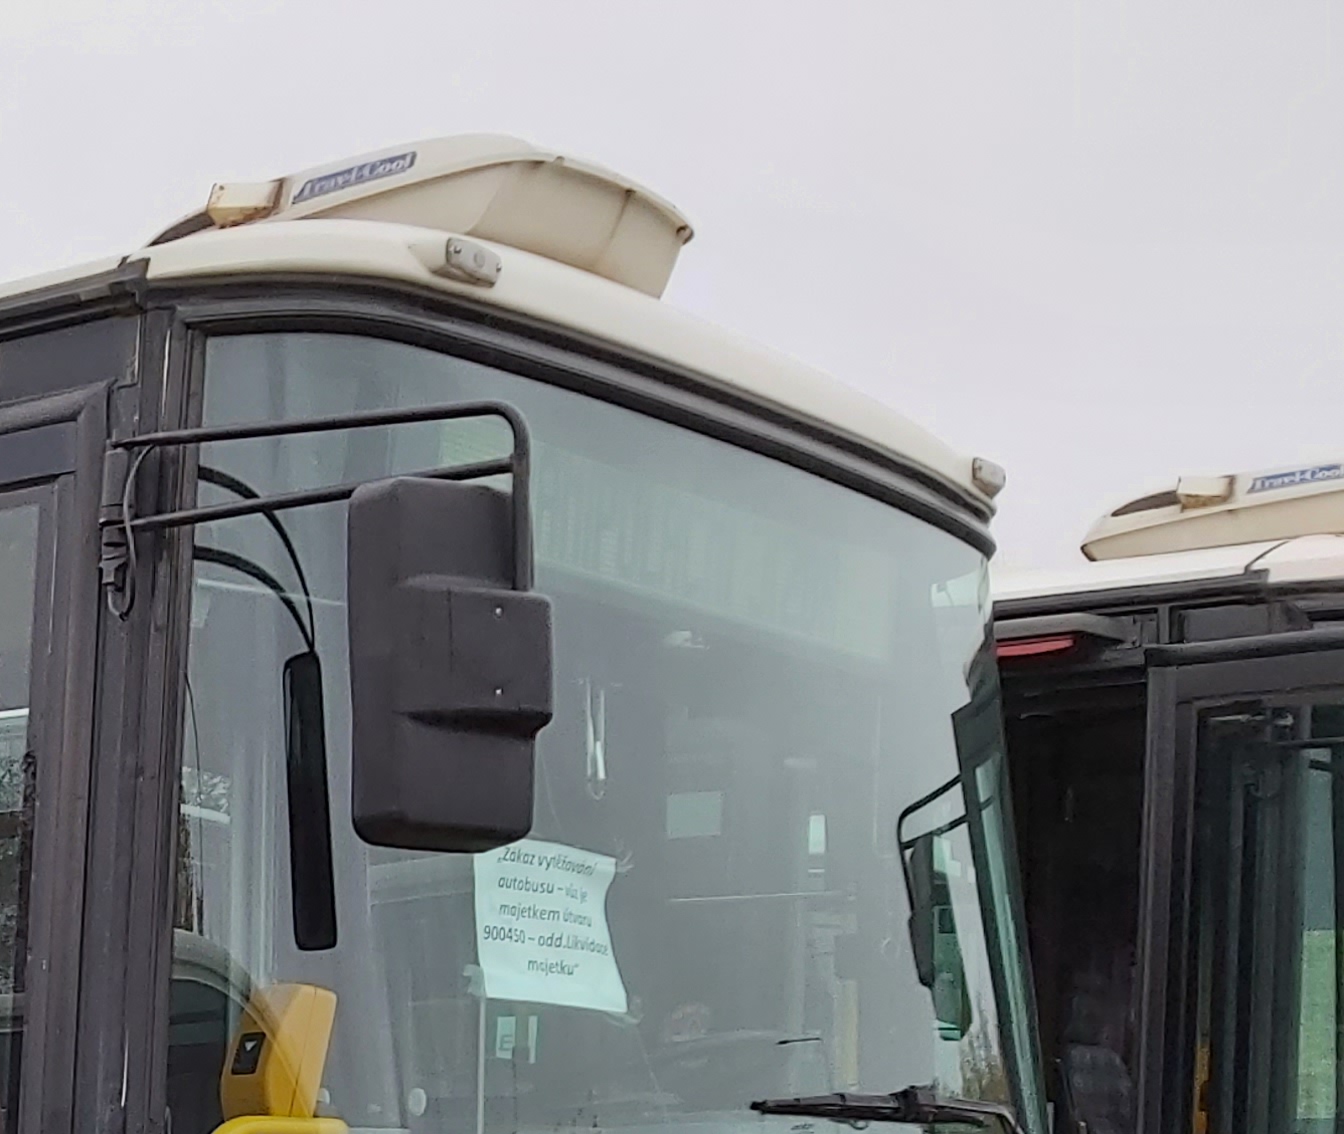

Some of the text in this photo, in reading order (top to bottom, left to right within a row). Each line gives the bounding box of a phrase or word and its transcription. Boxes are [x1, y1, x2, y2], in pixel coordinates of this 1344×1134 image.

[498, 875, 555, 894] autobusu
[499, 902, 561, 921] majetkem
[483, 925, 526, 944] 900450
